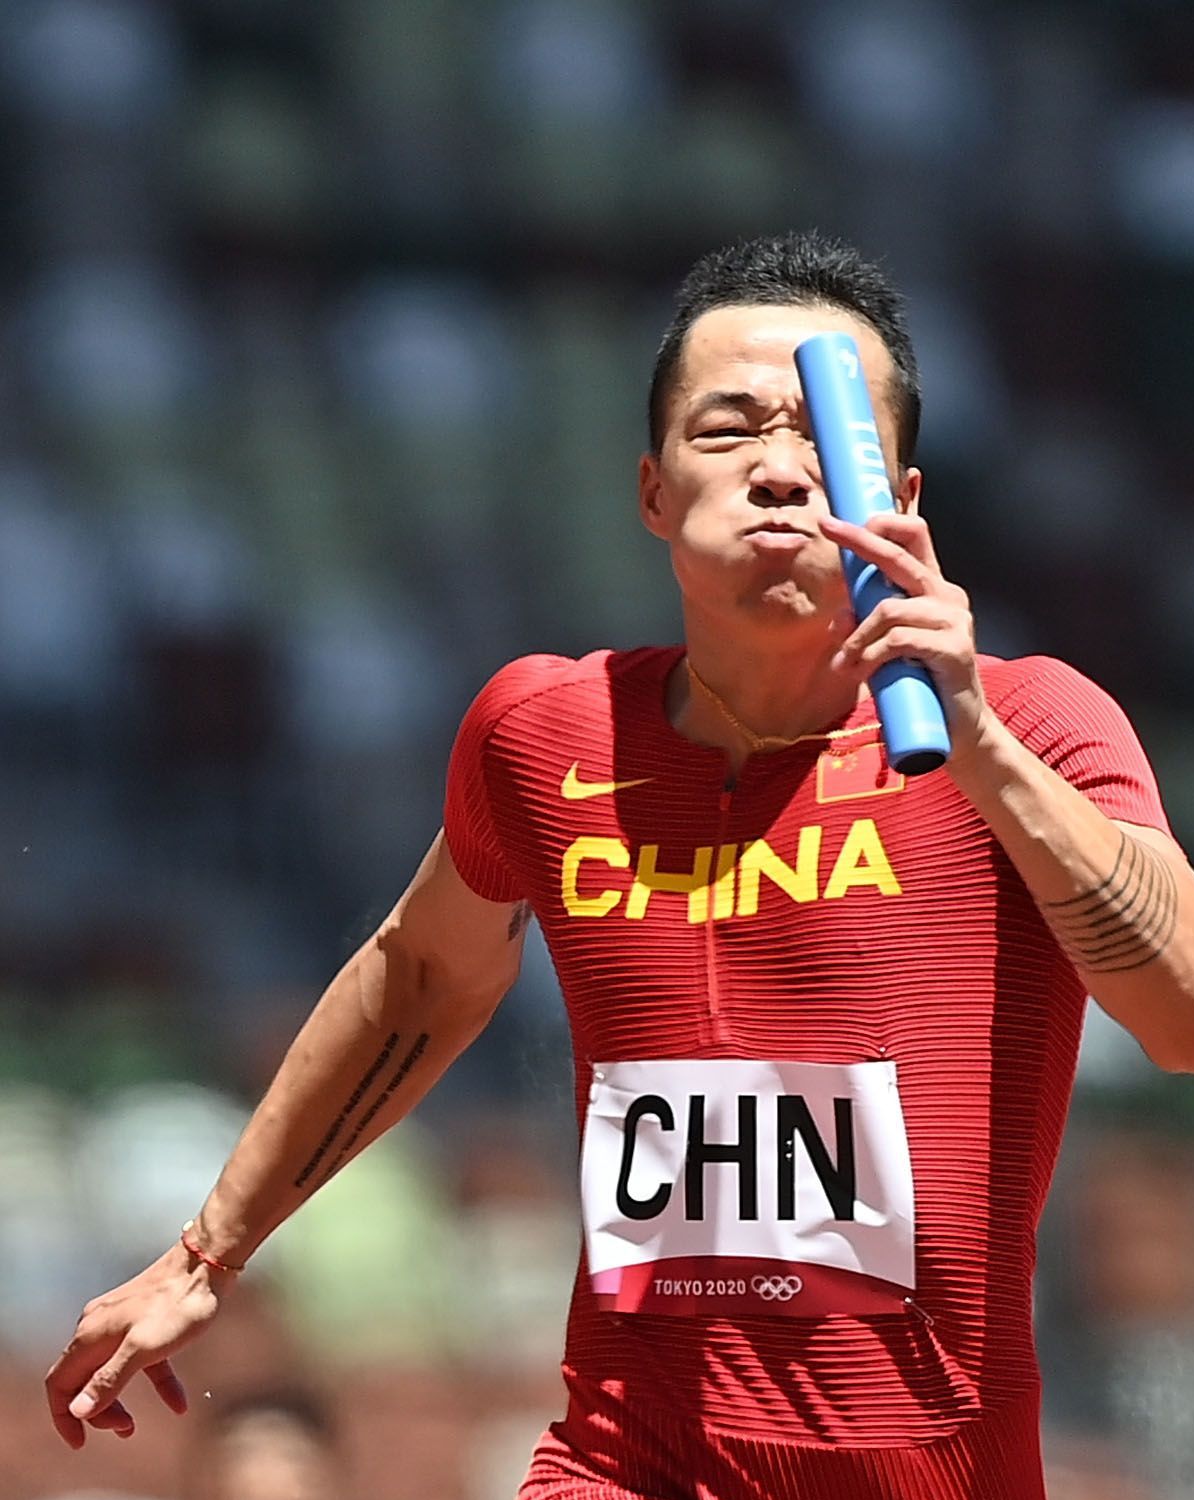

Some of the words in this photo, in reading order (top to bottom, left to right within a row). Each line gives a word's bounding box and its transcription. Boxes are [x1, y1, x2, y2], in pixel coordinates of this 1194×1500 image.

[561, 819, 902, 923] CHINA
[616, 1094, 856, 1221] CHN
[653, 1279, 702, 1296] TOKYO
[705, 1279, 746, 1295] 2020
